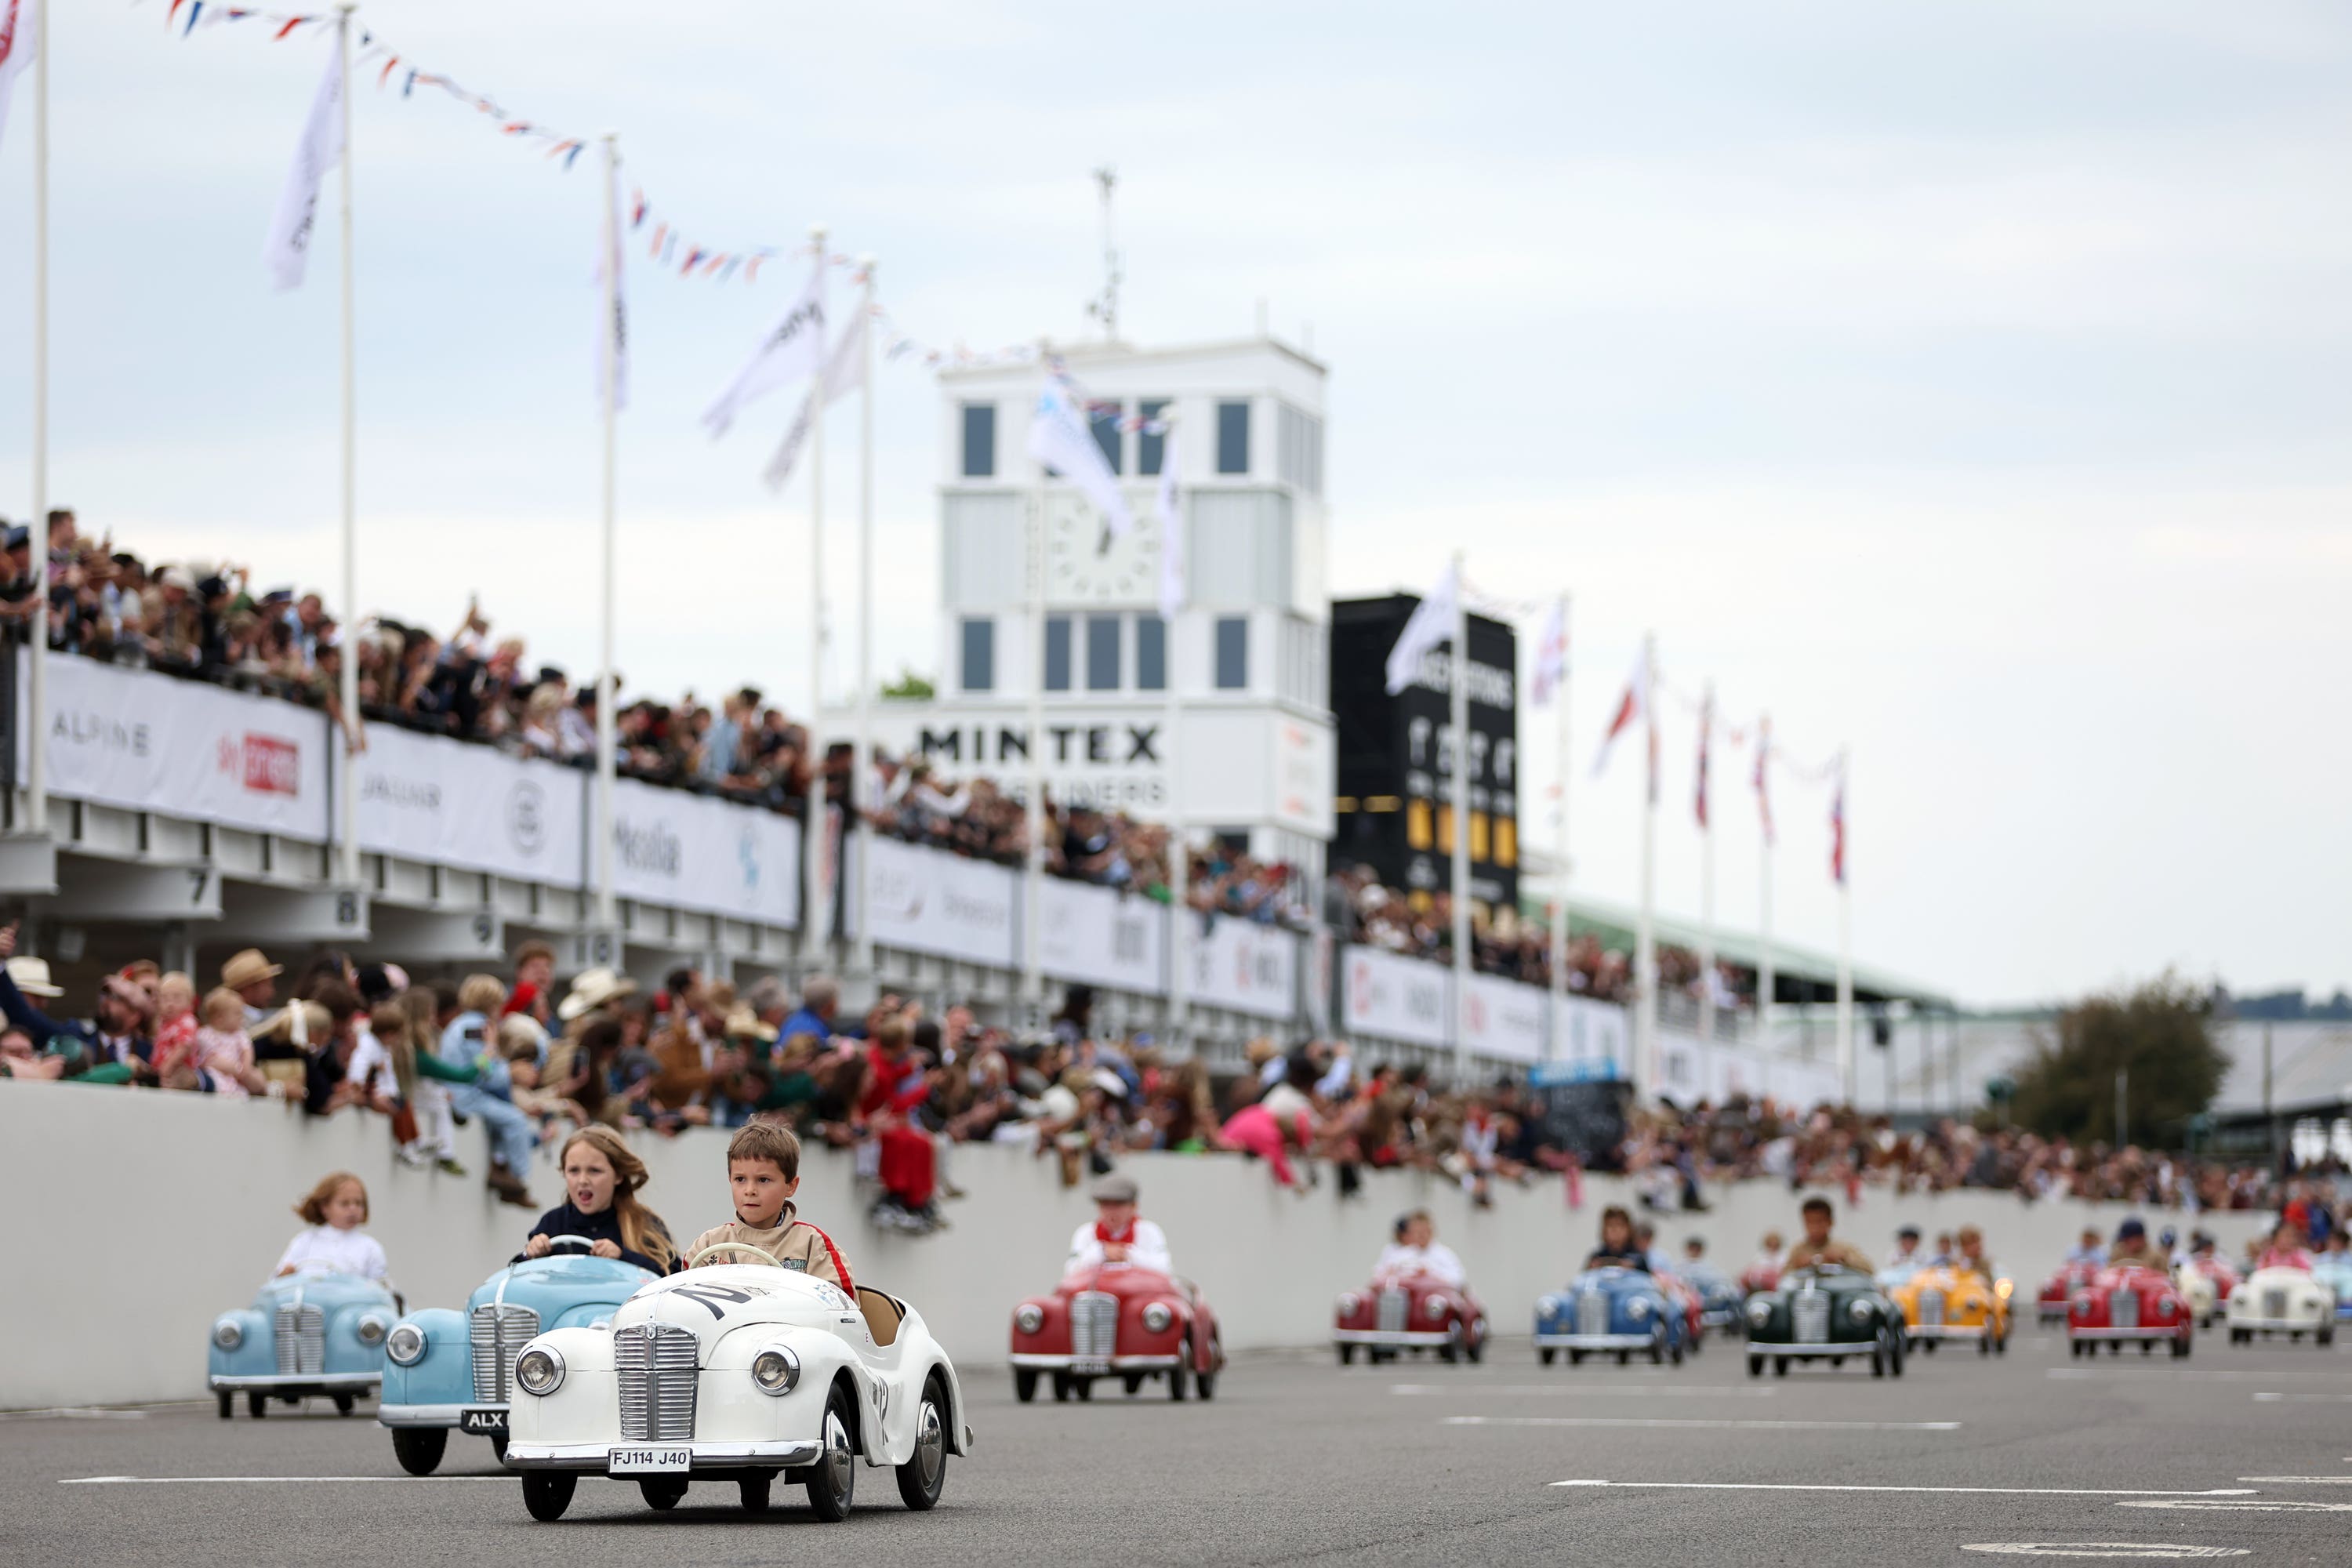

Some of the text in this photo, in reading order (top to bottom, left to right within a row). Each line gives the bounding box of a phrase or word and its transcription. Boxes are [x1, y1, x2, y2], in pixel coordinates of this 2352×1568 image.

[50, 710, 151, 757] ALPINE
[920, 727, 1158, 761] MINTEX
[187, 868, 208, 903] 7
[468, 1413, 503, 1427] ALX
[614, 1452, 687, 1465] FJ114 J40
